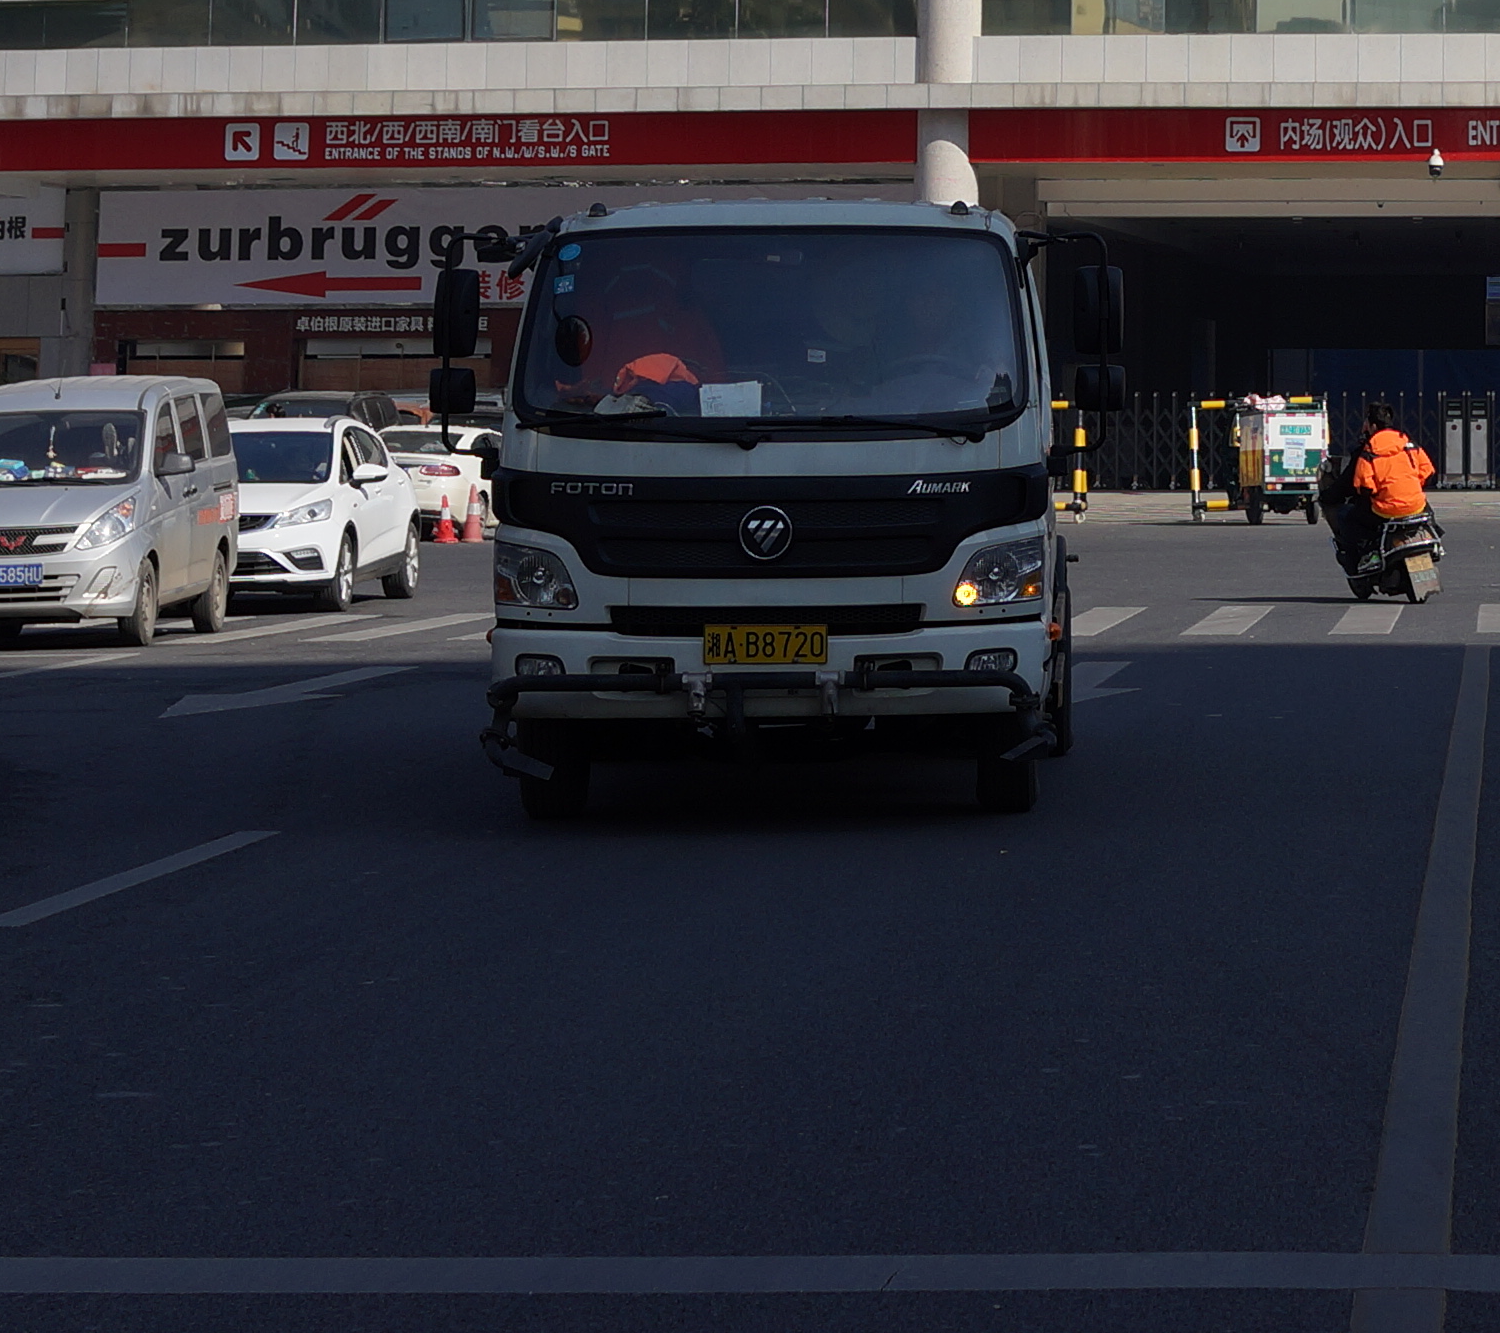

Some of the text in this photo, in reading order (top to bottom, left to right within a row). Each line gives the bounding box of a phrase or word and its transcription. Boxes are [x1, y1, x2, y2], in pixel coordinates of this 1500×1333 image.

[325, 119, 610, 145] 西北/西/西南/南门看台入口
[1280, 118, 1433, 150] 内场(观众)入口
[325, 147, 381, 160] ENTRANCE
[385, 147, 400, 160] OF
[404, 147, 425, 159] THE
[429, 147, 472, 159] STANDS
[476, 146, 490, 159] OF
[582, 145, 610, 158] GATE
[295, 315, 424, 332] 卓伯根原装进口家具
[550, 482, 633, 496] FOTON
